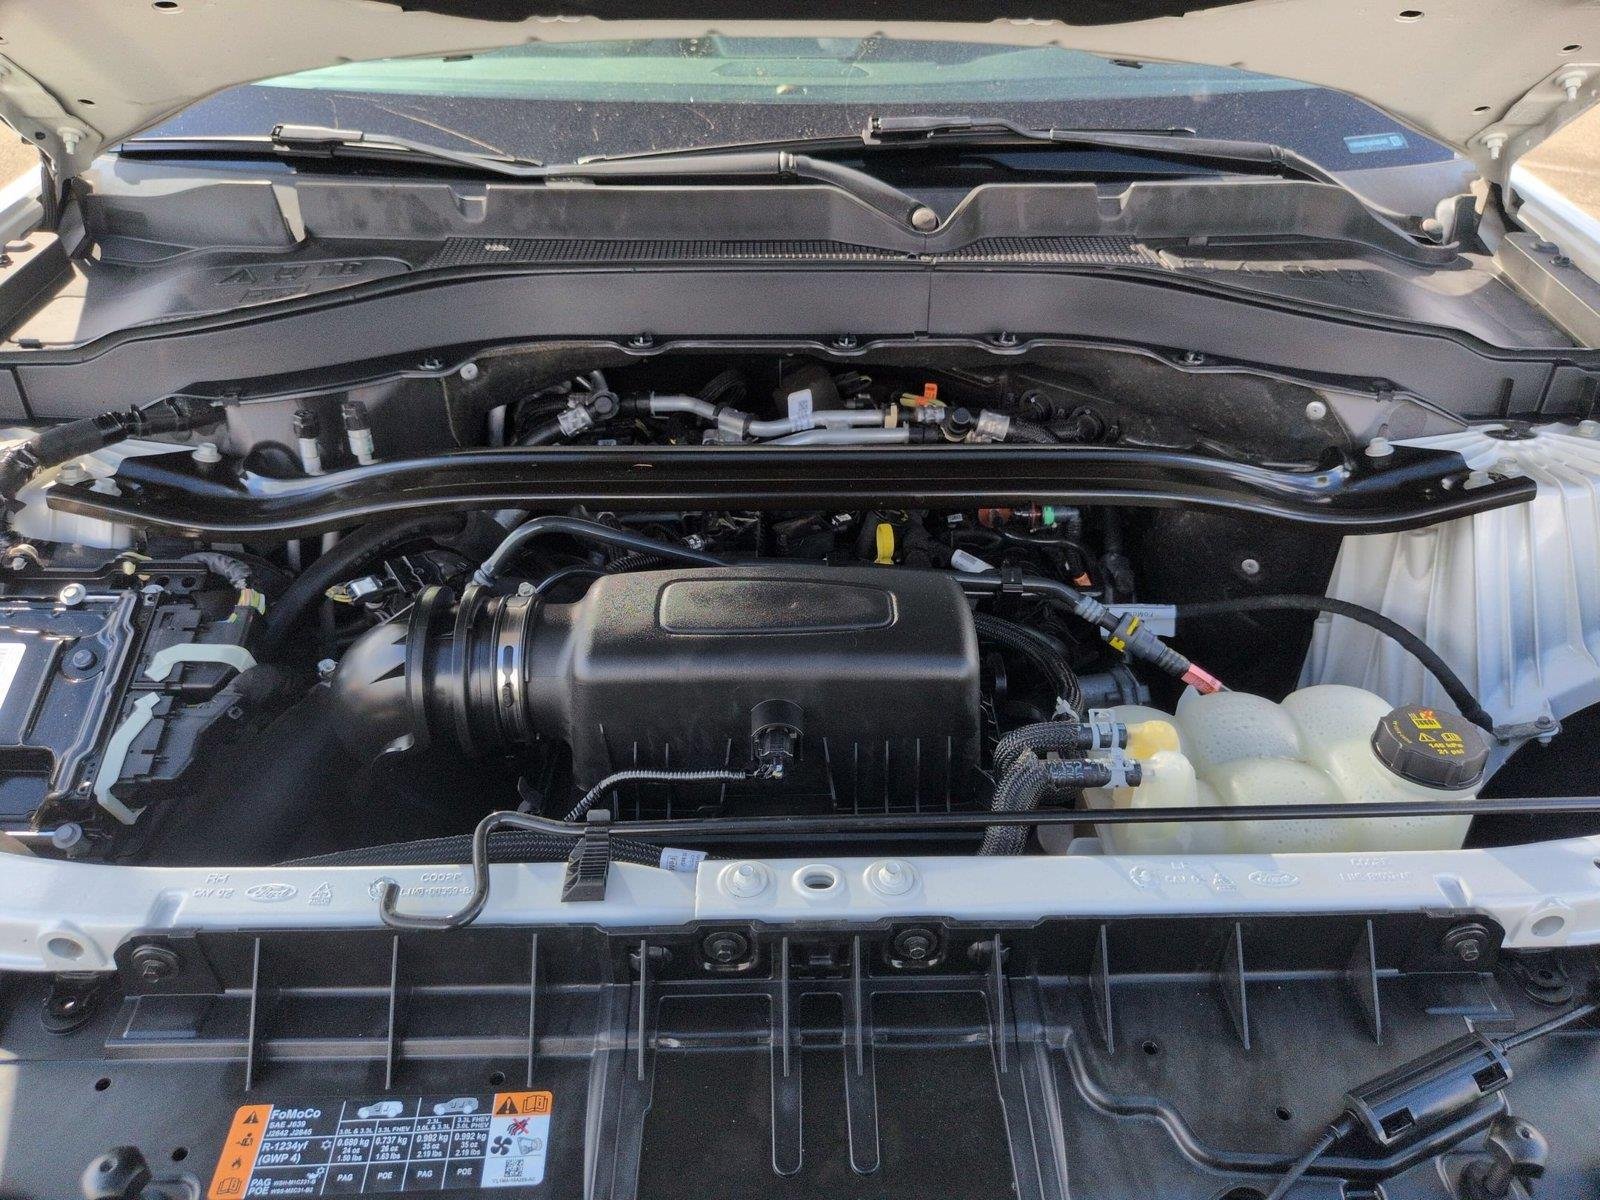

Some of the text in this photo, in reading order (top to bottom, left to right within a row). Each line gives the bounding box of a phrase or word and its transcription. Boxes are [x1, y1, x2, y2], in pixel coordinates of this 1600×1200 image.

[270, 1108, 321, 1119] FoMoCo
[287, 1120, 306, 1128] J639
[375, 1136, 407, 1145] 0.737 kg
[417, 1134, 448, 1143] 0.992 kg
[477, 1132, 487, 1142] kg
[262, 1140, 309, 1152] R-1234yf
[360, 1138, 370, 1147] kg
[258, 1153, 301, 1165] (GWP 4)
[417, 1170, 433, 1178] PAG
[250, 1178, 272, 1187] PAG
[248, 1186, 269, 1195] POE
